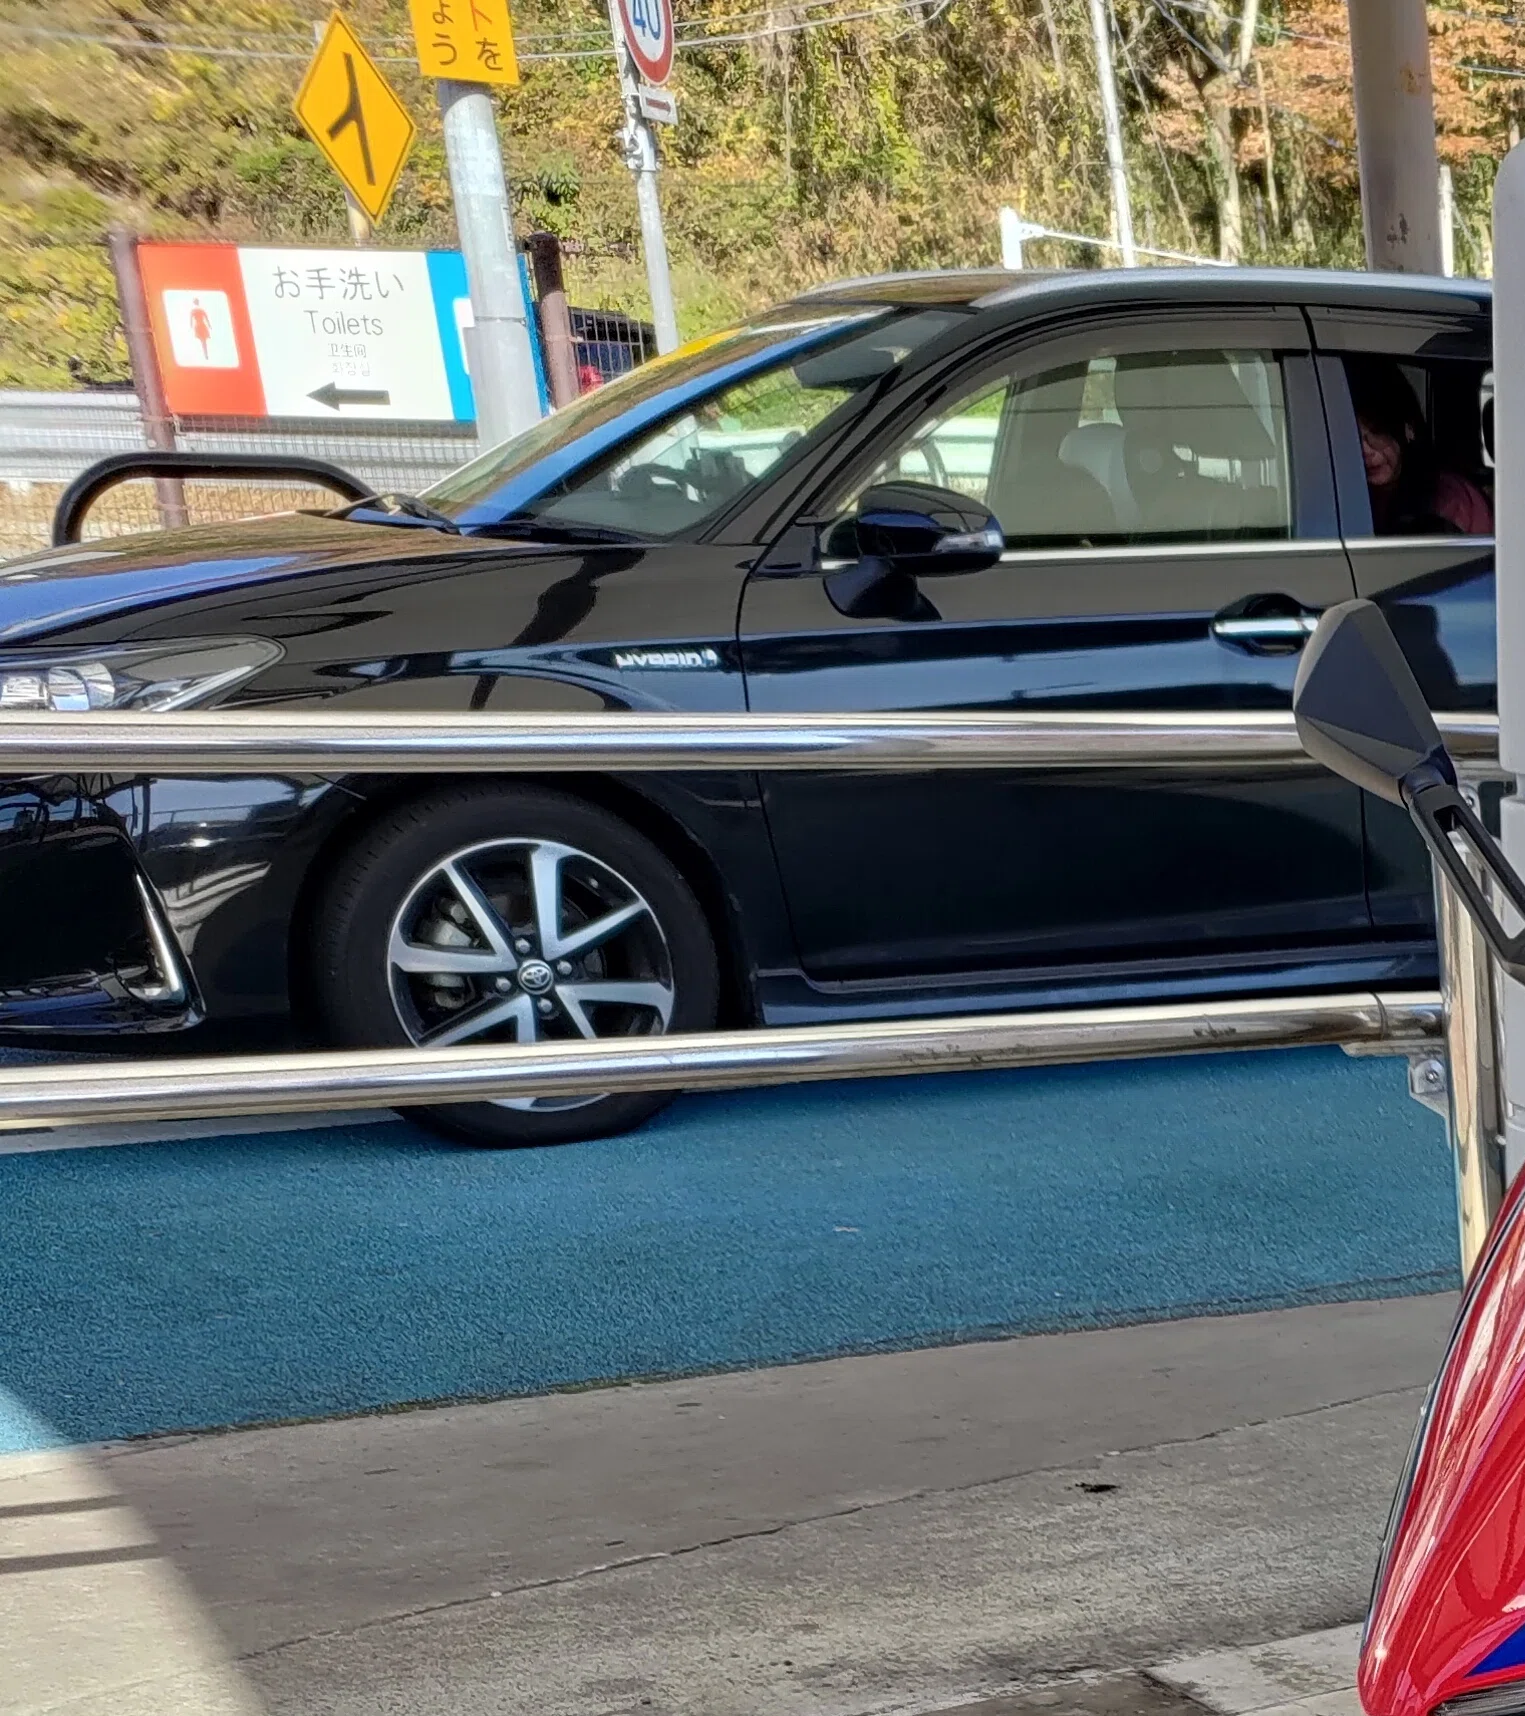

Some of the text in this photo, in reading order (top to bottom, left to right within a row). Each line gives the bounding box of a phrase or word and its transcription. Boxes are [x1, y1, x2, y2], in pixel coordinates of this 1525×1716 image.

[272, 265, 404, 300] お手洗い
[303, 310, 384, 336] Toilets
